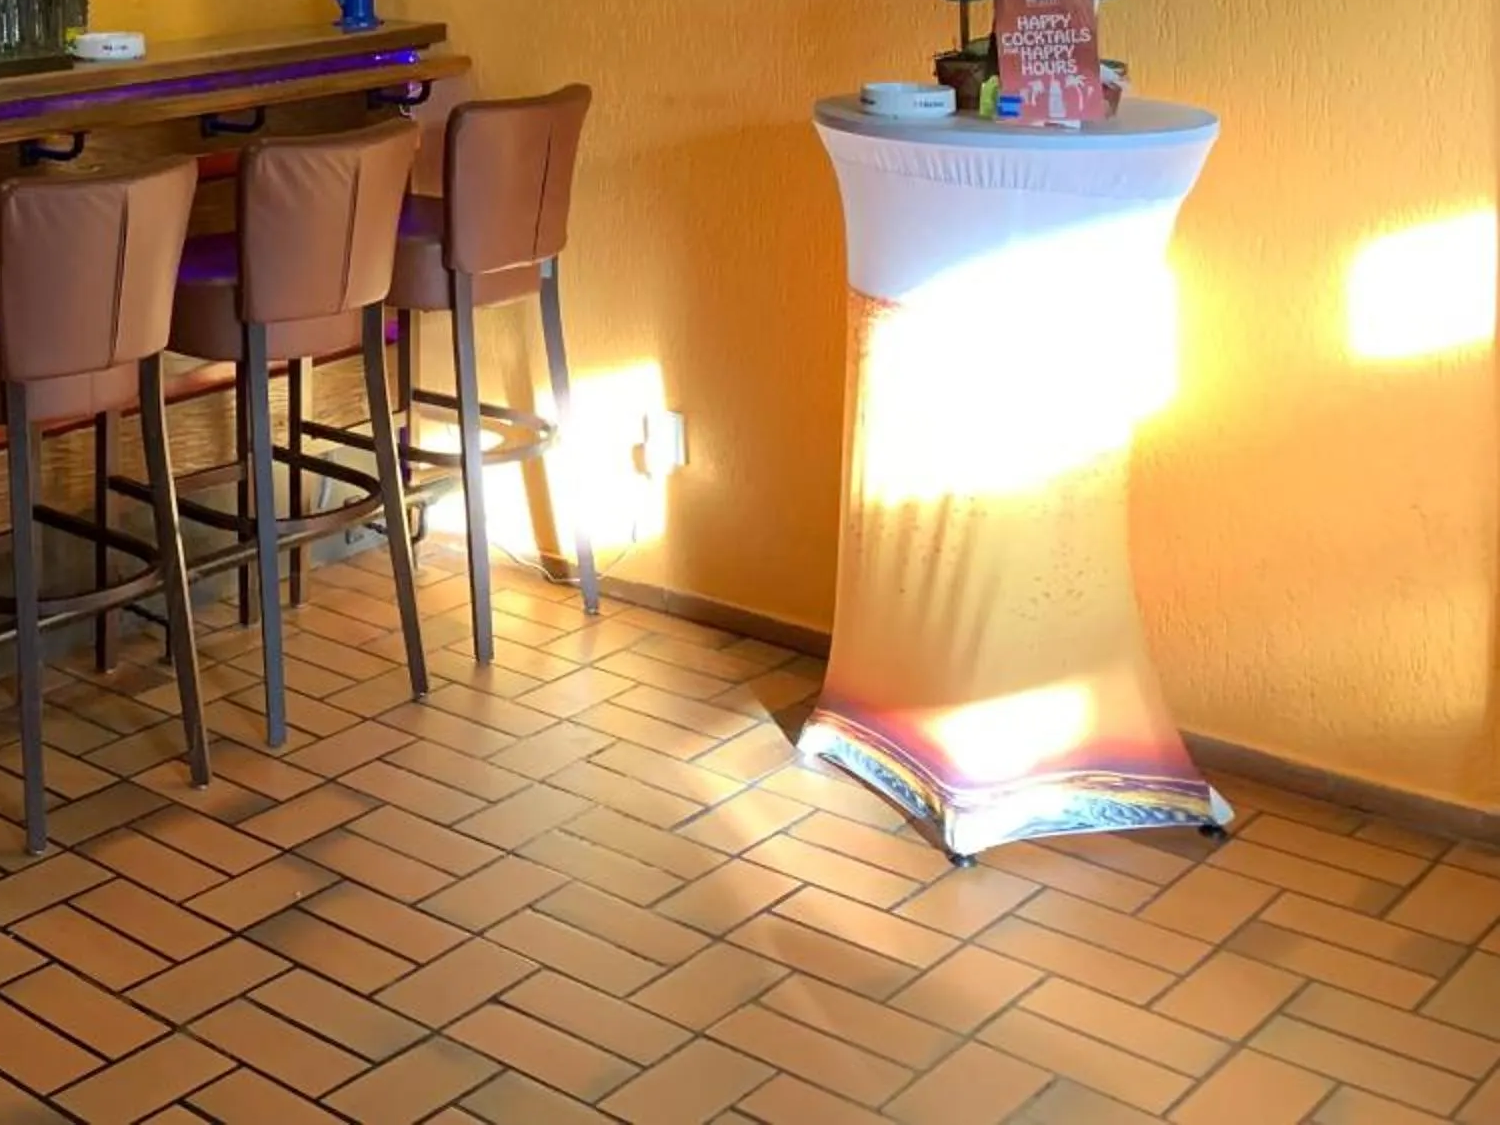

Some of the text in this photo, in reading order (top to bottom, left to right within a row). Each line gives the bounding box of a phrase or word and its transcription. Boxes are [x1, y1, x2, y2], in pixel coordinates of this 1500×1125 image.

[1017, 12, 1071, 31] HAPPY
[1001, 27, 1092, 46] COCKTAILS
[1021, 44, 1075, 61] HAPPY
[1021, 58, 1078, 76] HOURS
